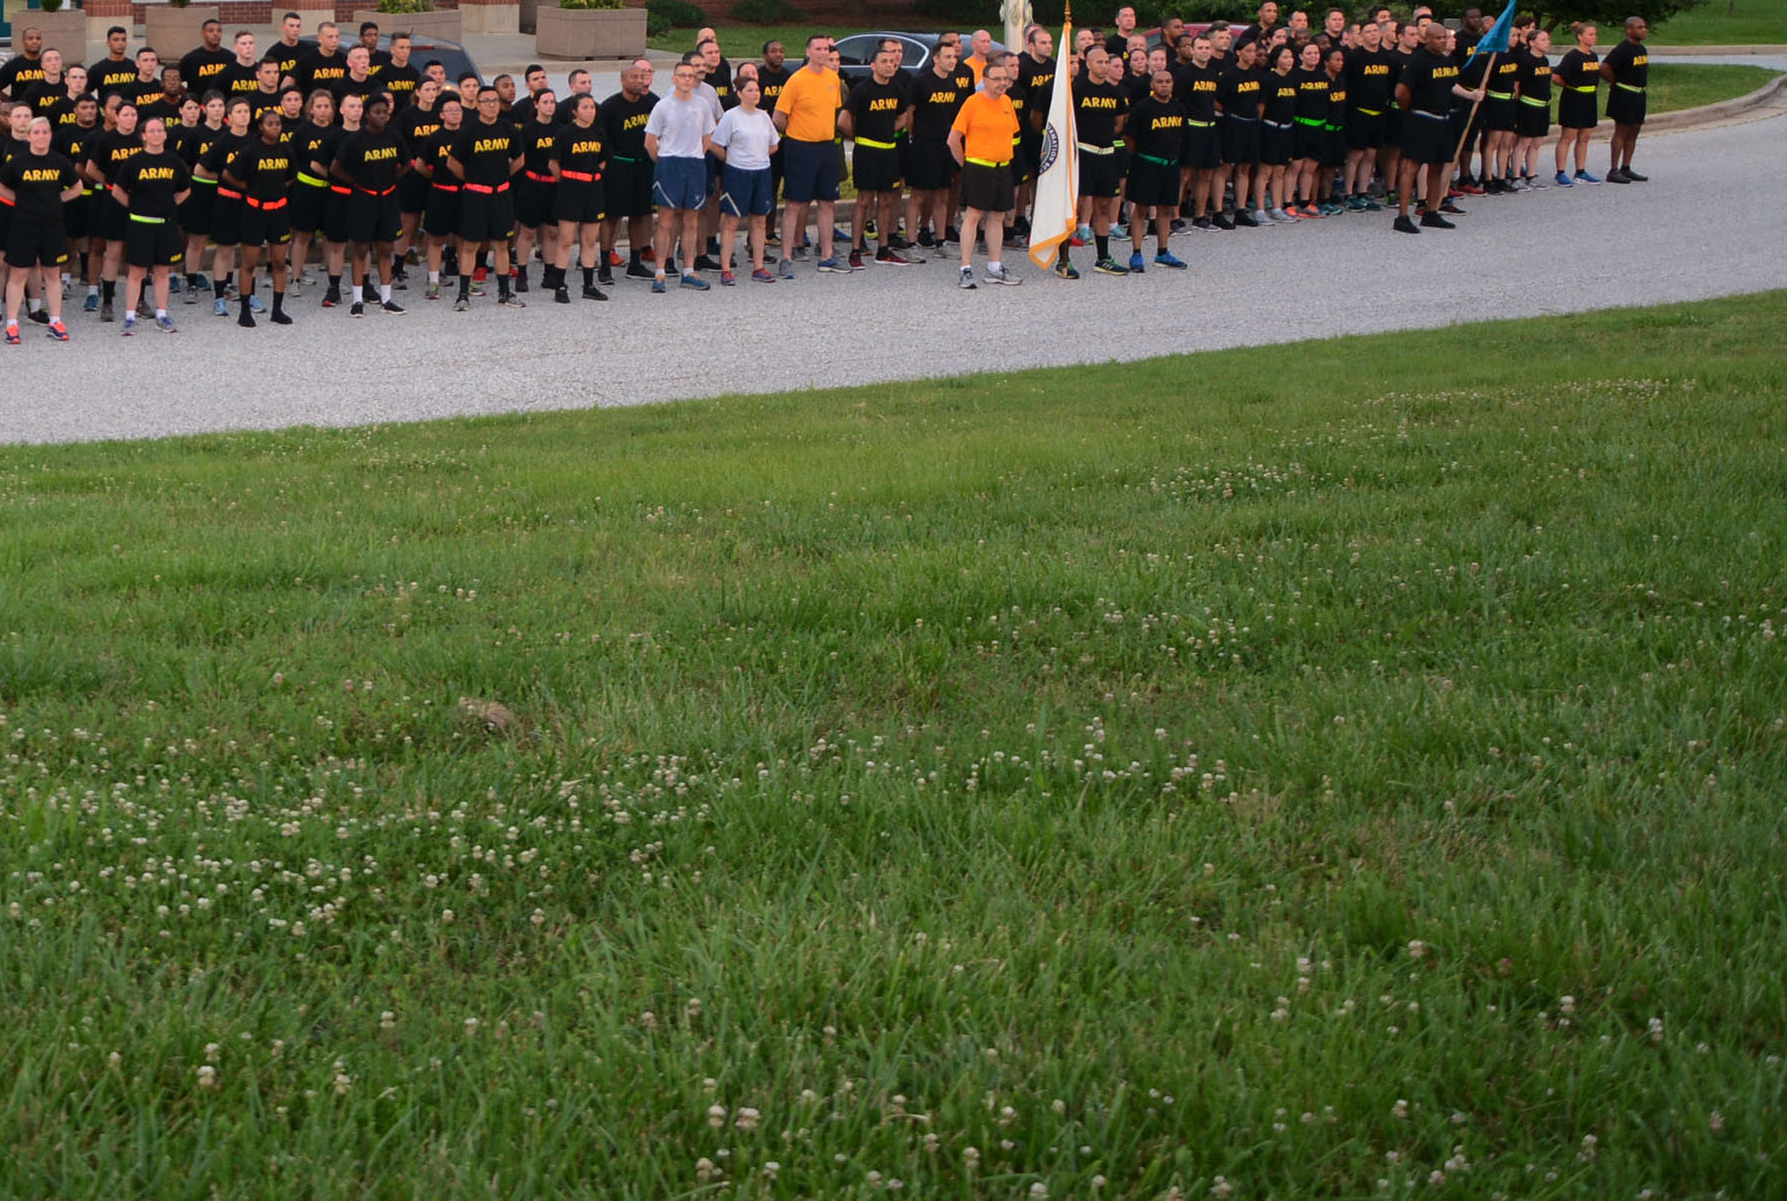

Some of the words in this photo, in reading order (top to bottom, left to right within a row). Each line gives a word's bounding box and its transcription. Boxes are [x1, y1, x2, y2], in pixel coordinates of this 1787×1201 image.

[198, 63, 227, 77] ARM
[280, 59, 297, 72] AR
[15, 69, 48, 82] ARM
[103, 72, 137, 86] ARMY
[313, 67, 345, 80] ARMY
[1030, 73, 1054, 87] AR
[231, 79, 261, 91] ARM
[387, 80, 416, 91] ARMY
[956, 77, 970, 88] MY
[38, 95, 60, 107] AR
[869, 98, 899, 111] ARMY
[1081, 96, 1117, 109] ARMY
[59, 112, 78, 124] AR
[623, 113, 649, 130] ARM
[1151, 116, 1183, 130] ARMY
[474, 137, 510, 153] ARMY
[536, 136, 554, 149] AR
[111, 147, 143, 160] AR
[364, 147, 397, 162] ARMY
[22, 168, 61, 182] ARMY
[138, 167, 175, 181] ARMY
